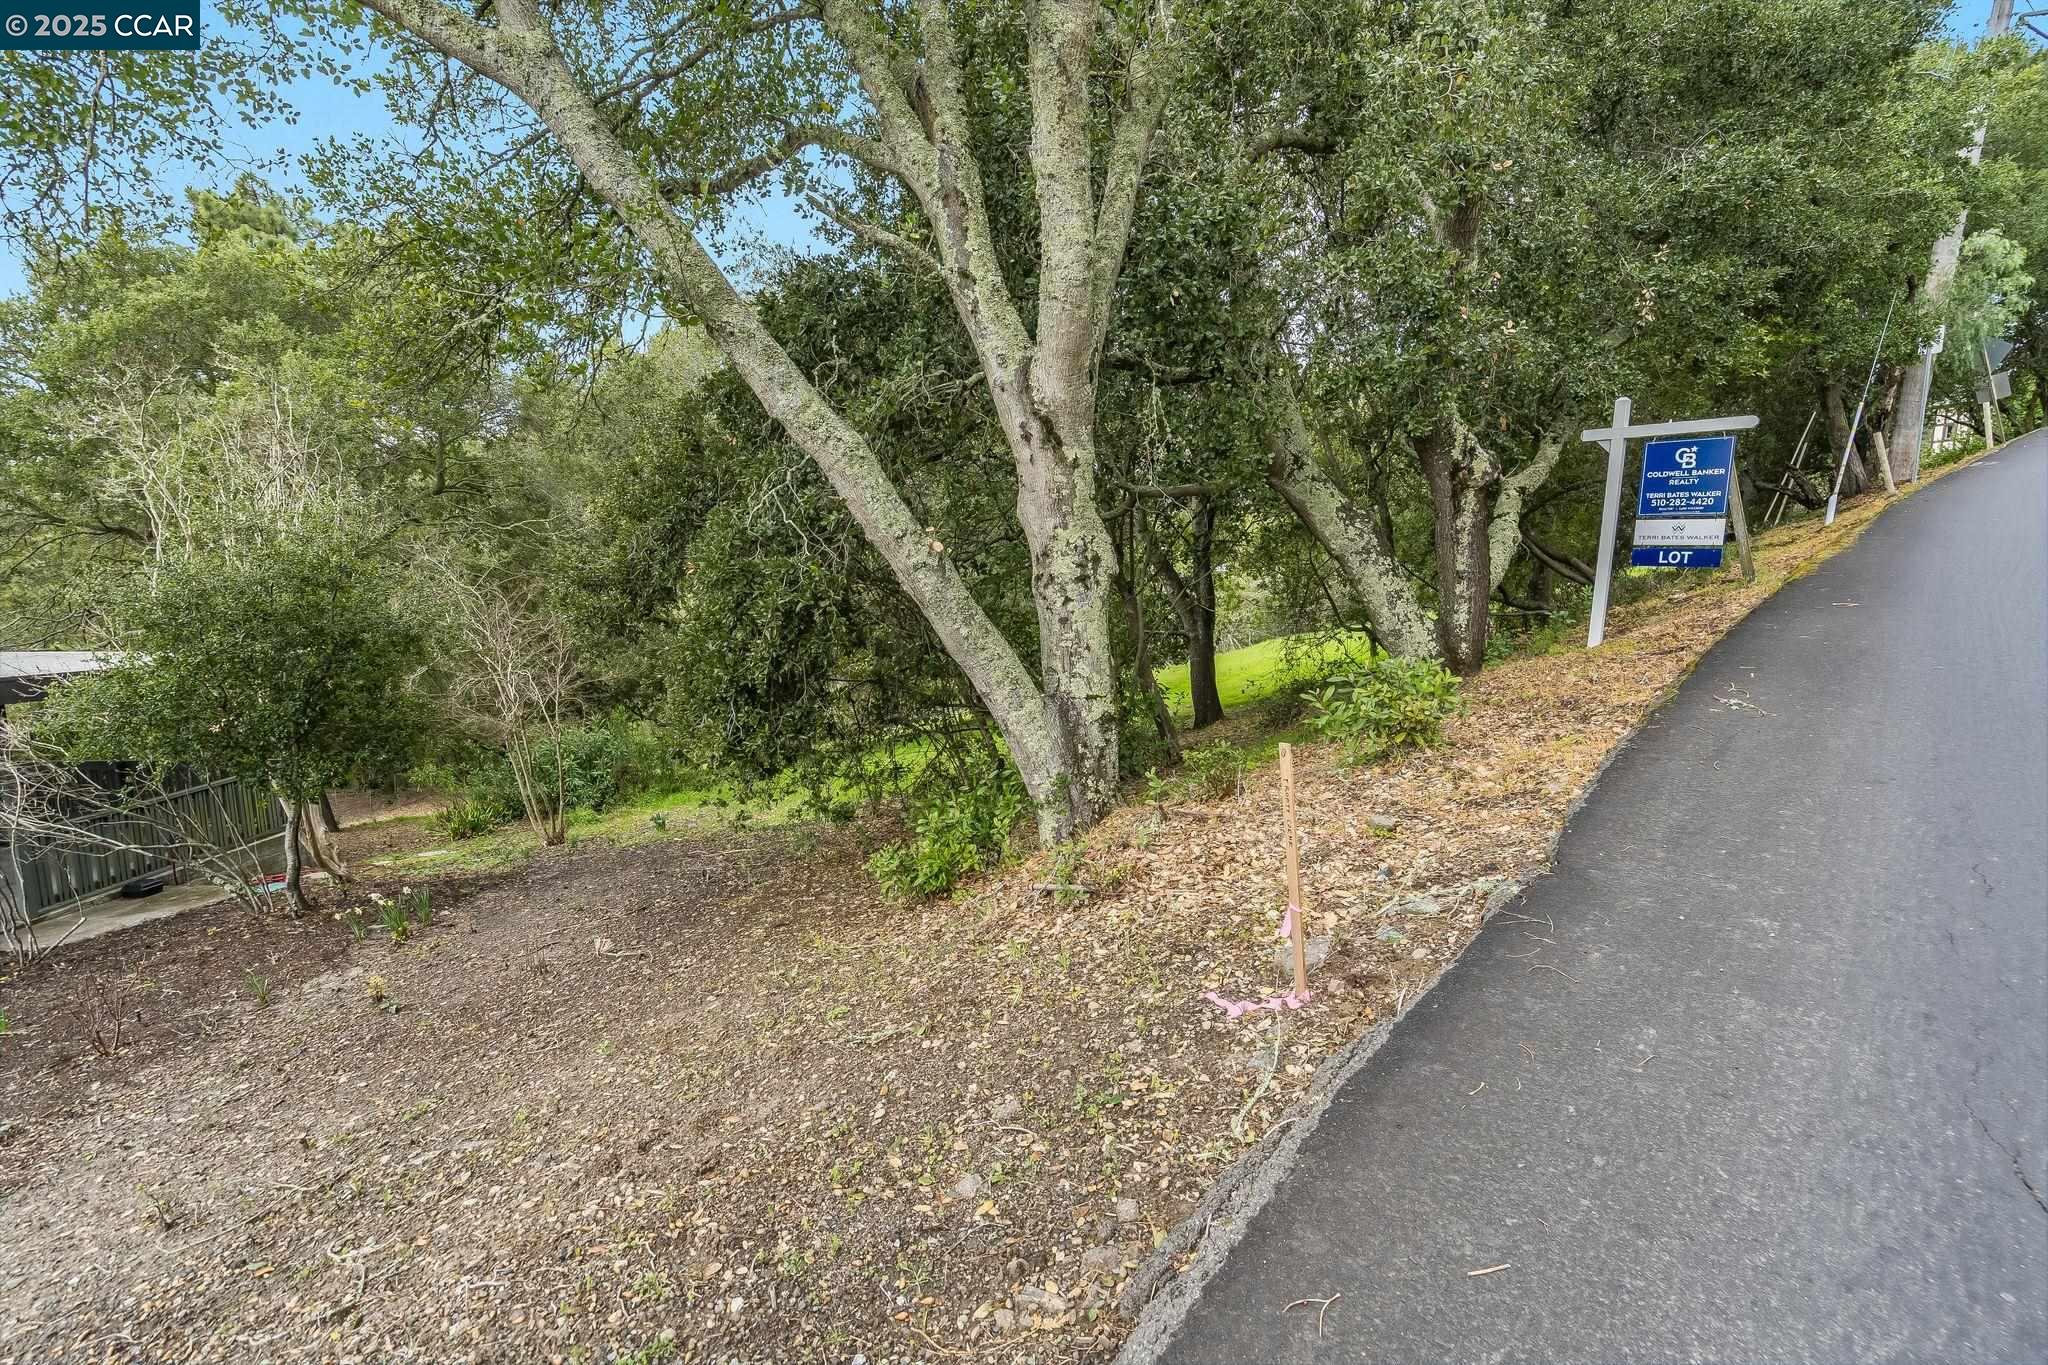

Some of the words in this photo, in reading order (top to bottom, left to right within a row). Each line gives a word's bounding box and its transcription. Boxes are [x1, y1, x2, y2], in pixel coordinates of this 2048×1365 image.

[1647, 470, 1689, 478] COLDWELL
[1650, 498, 1714, 507] 510-282-4420
[1658, 551, 1694, 564] LOT
